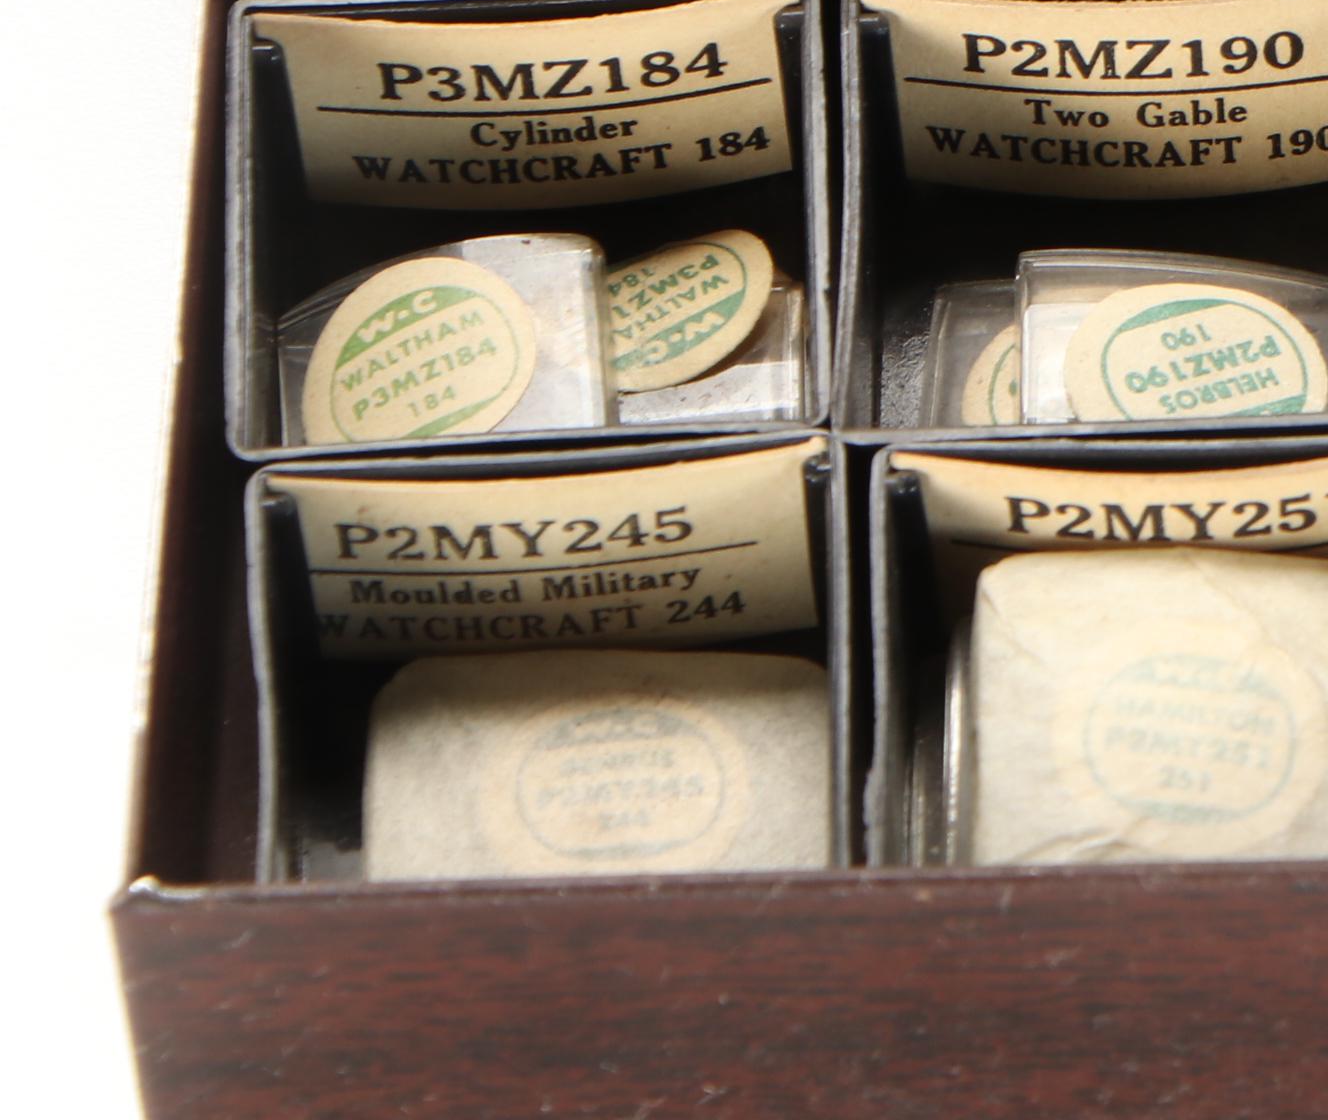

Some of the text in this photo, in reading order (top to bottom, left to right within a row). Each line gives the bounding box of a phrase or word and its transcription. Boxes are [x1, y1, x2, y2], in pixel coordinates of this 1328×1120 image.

[377, 42, 728, 103] P3MZ184
[961, 30, 1305, 80] P2MZ190
[469, 115, 638, 150] Cylinder
[1024, 97, 1248, 128] Two Gable
[352, 125, 772, 185] WATCHCRAFT 184
[926, 125, 1243, 168] WATCHCRAFT
[611, 254, 721, 319] P3MZ1
[612, 274, 730, 340] WALTHA
[357, 290, 438, 343] W-C
[1160, 323, 1212, 351] 190
[340, 309, 485, 392] WALTHAM
[1124, 335, 1282, 394] P2MZ190
[351, 337, 498, 422] P3MZ184
[407, 385, 457, 418] 184
[1158, 367, 1280, 415] HELBROS
[334, 505, 693, 561] P2MY245
[350, 567, 703, 606] Moulded Military
[317, 591, 747, 642] WATCHCRAFT 244
